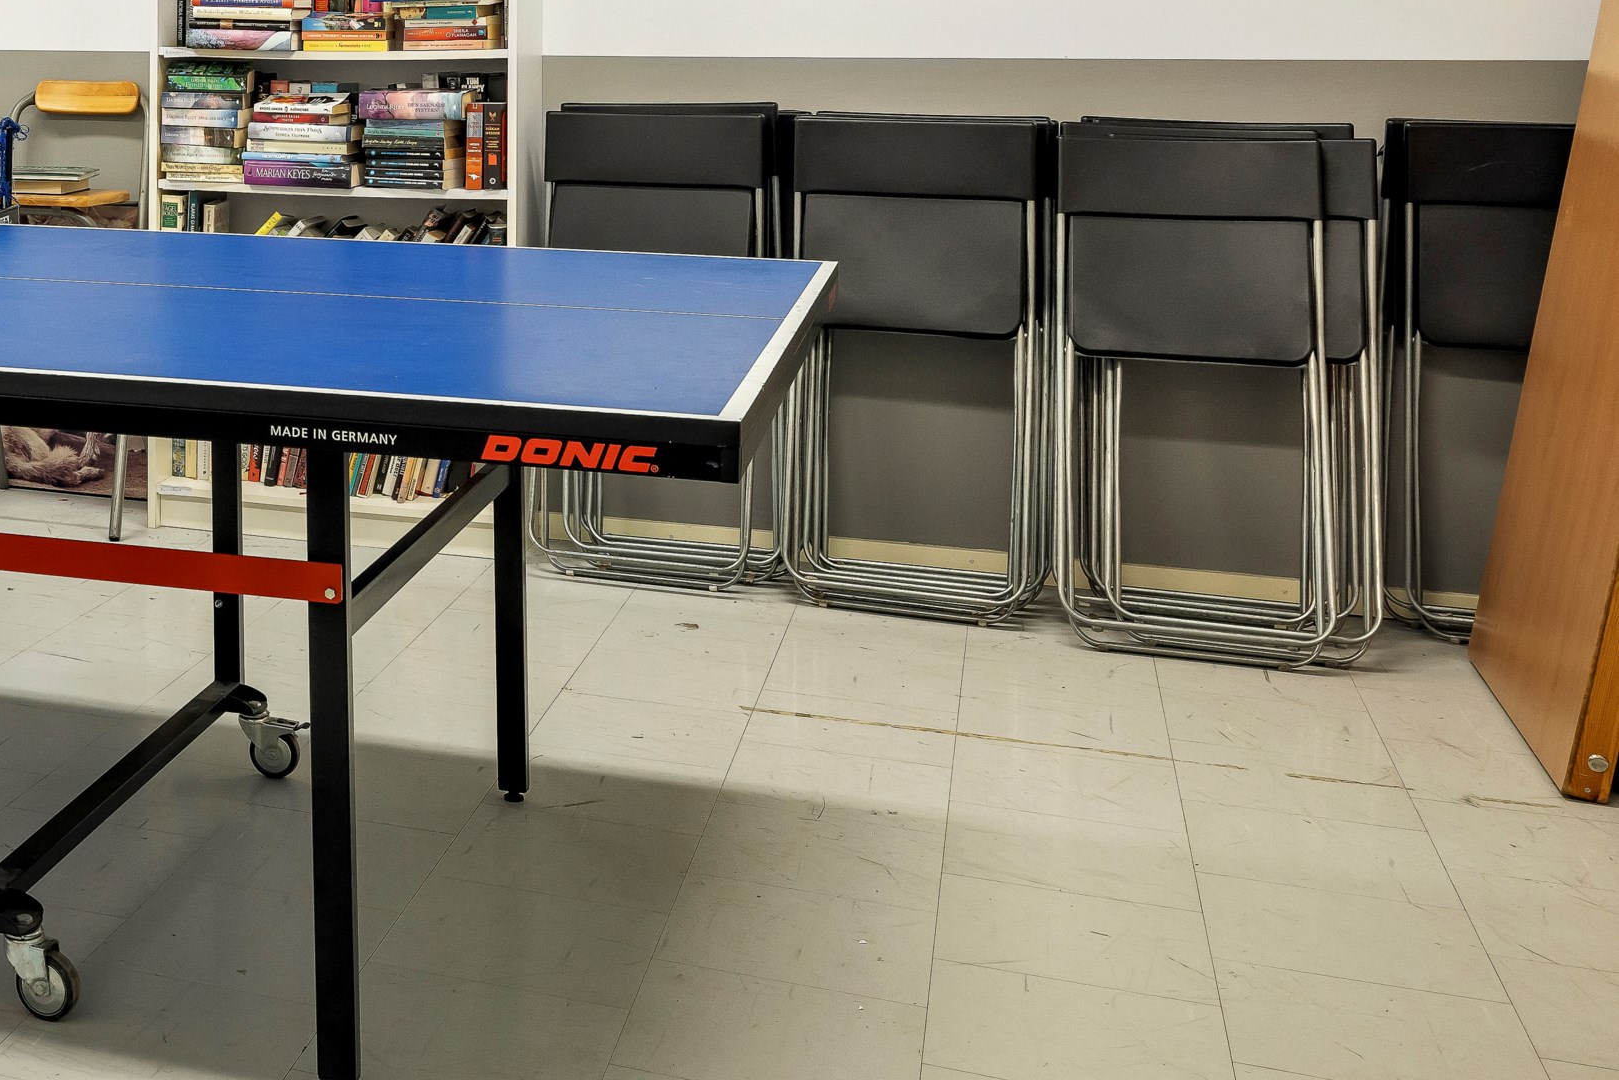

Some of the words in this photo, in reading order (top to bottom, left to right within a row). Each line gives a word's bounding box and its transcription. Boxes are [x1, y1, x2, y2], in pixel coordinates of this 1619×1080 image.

[256, 168, 286, 177] MARIAN
[287, 169, 311, 179] KEYES
[270, 425, 308, 438] MADE
[313, 428, 327, 439] IN
[332, 430, 398, 446] GERMANY
[481, 434, 657, 472] DONIC
